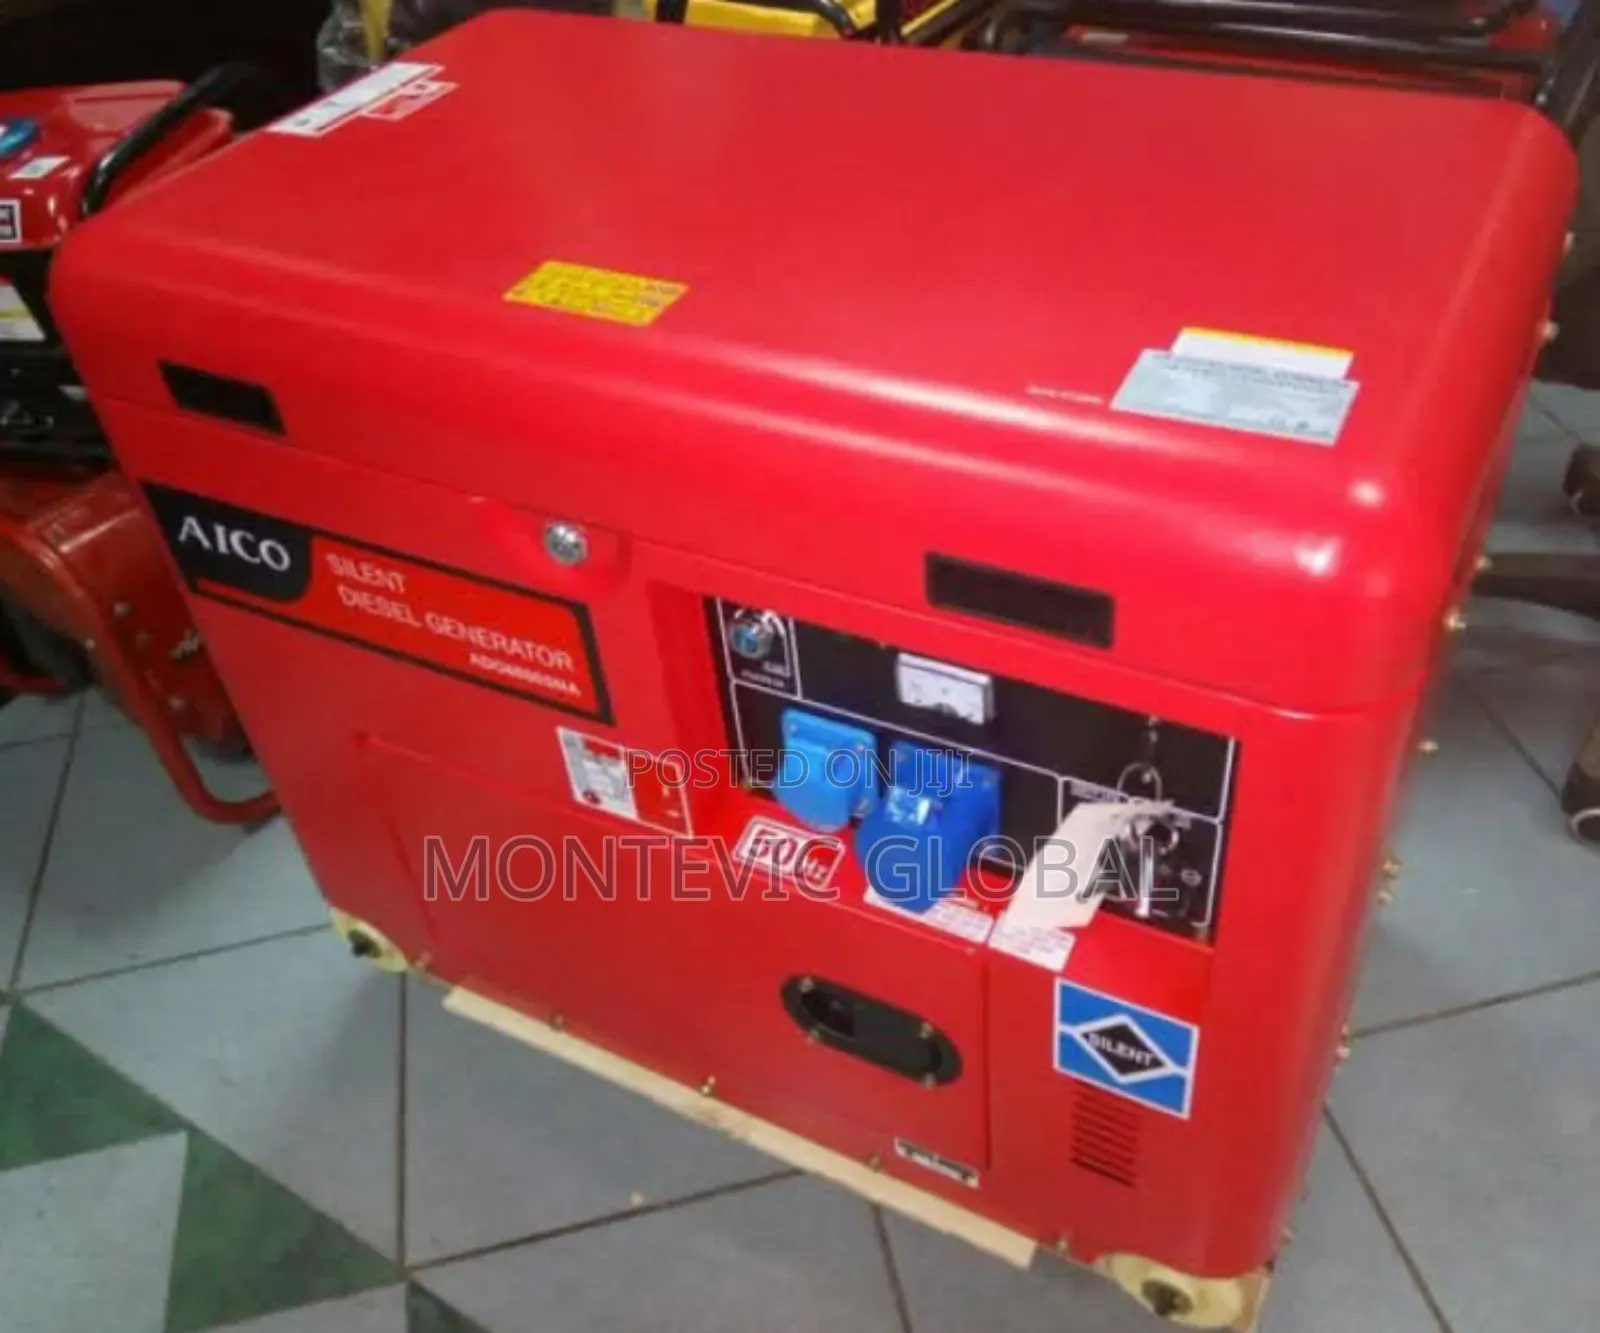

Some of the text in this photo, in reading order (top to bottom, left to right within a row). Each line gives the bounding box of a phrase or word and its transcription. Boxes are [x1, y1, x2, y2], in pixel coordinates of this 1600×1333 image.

[178, 515, 291, 572] AICO
[326, 552, 406, 594] SILENT
[336, 584, 574, 673] DIESEL GENERATOR
[1085, 1031, 1155, 1068] SILENT
